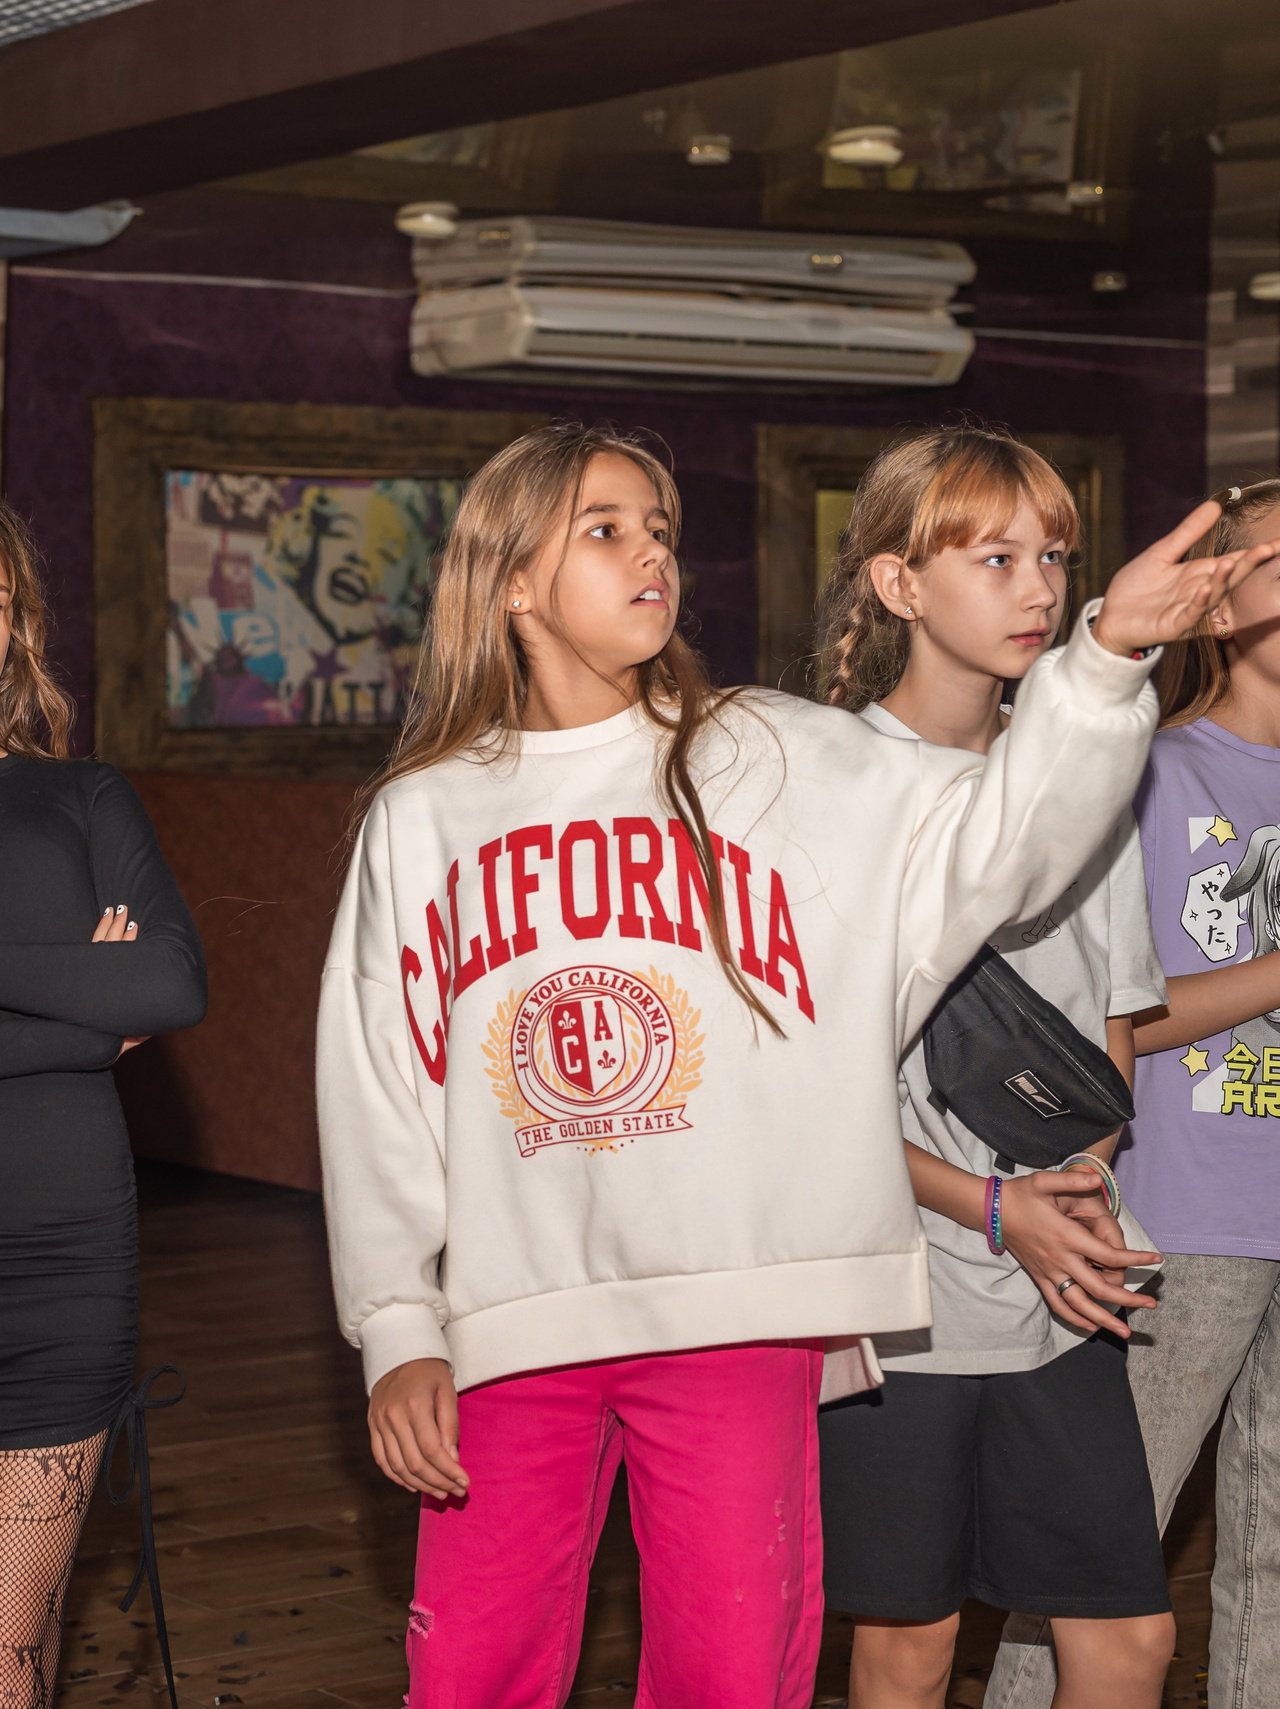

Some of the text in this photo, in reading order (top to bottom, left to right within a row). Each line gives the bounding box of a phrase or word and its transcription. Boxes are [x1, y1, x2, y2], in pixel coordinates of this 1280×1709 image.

[1201, 881, 1226, 946] やった
[401, 817, 815, 1087] CALIFORNIA
[516, 971, 670, 1072] I LOVE YOU CALIFORNIA
[561, 1000, 613, 1075] C A
[522, 1113, 675, 1146] THE GOLDEN STATE
